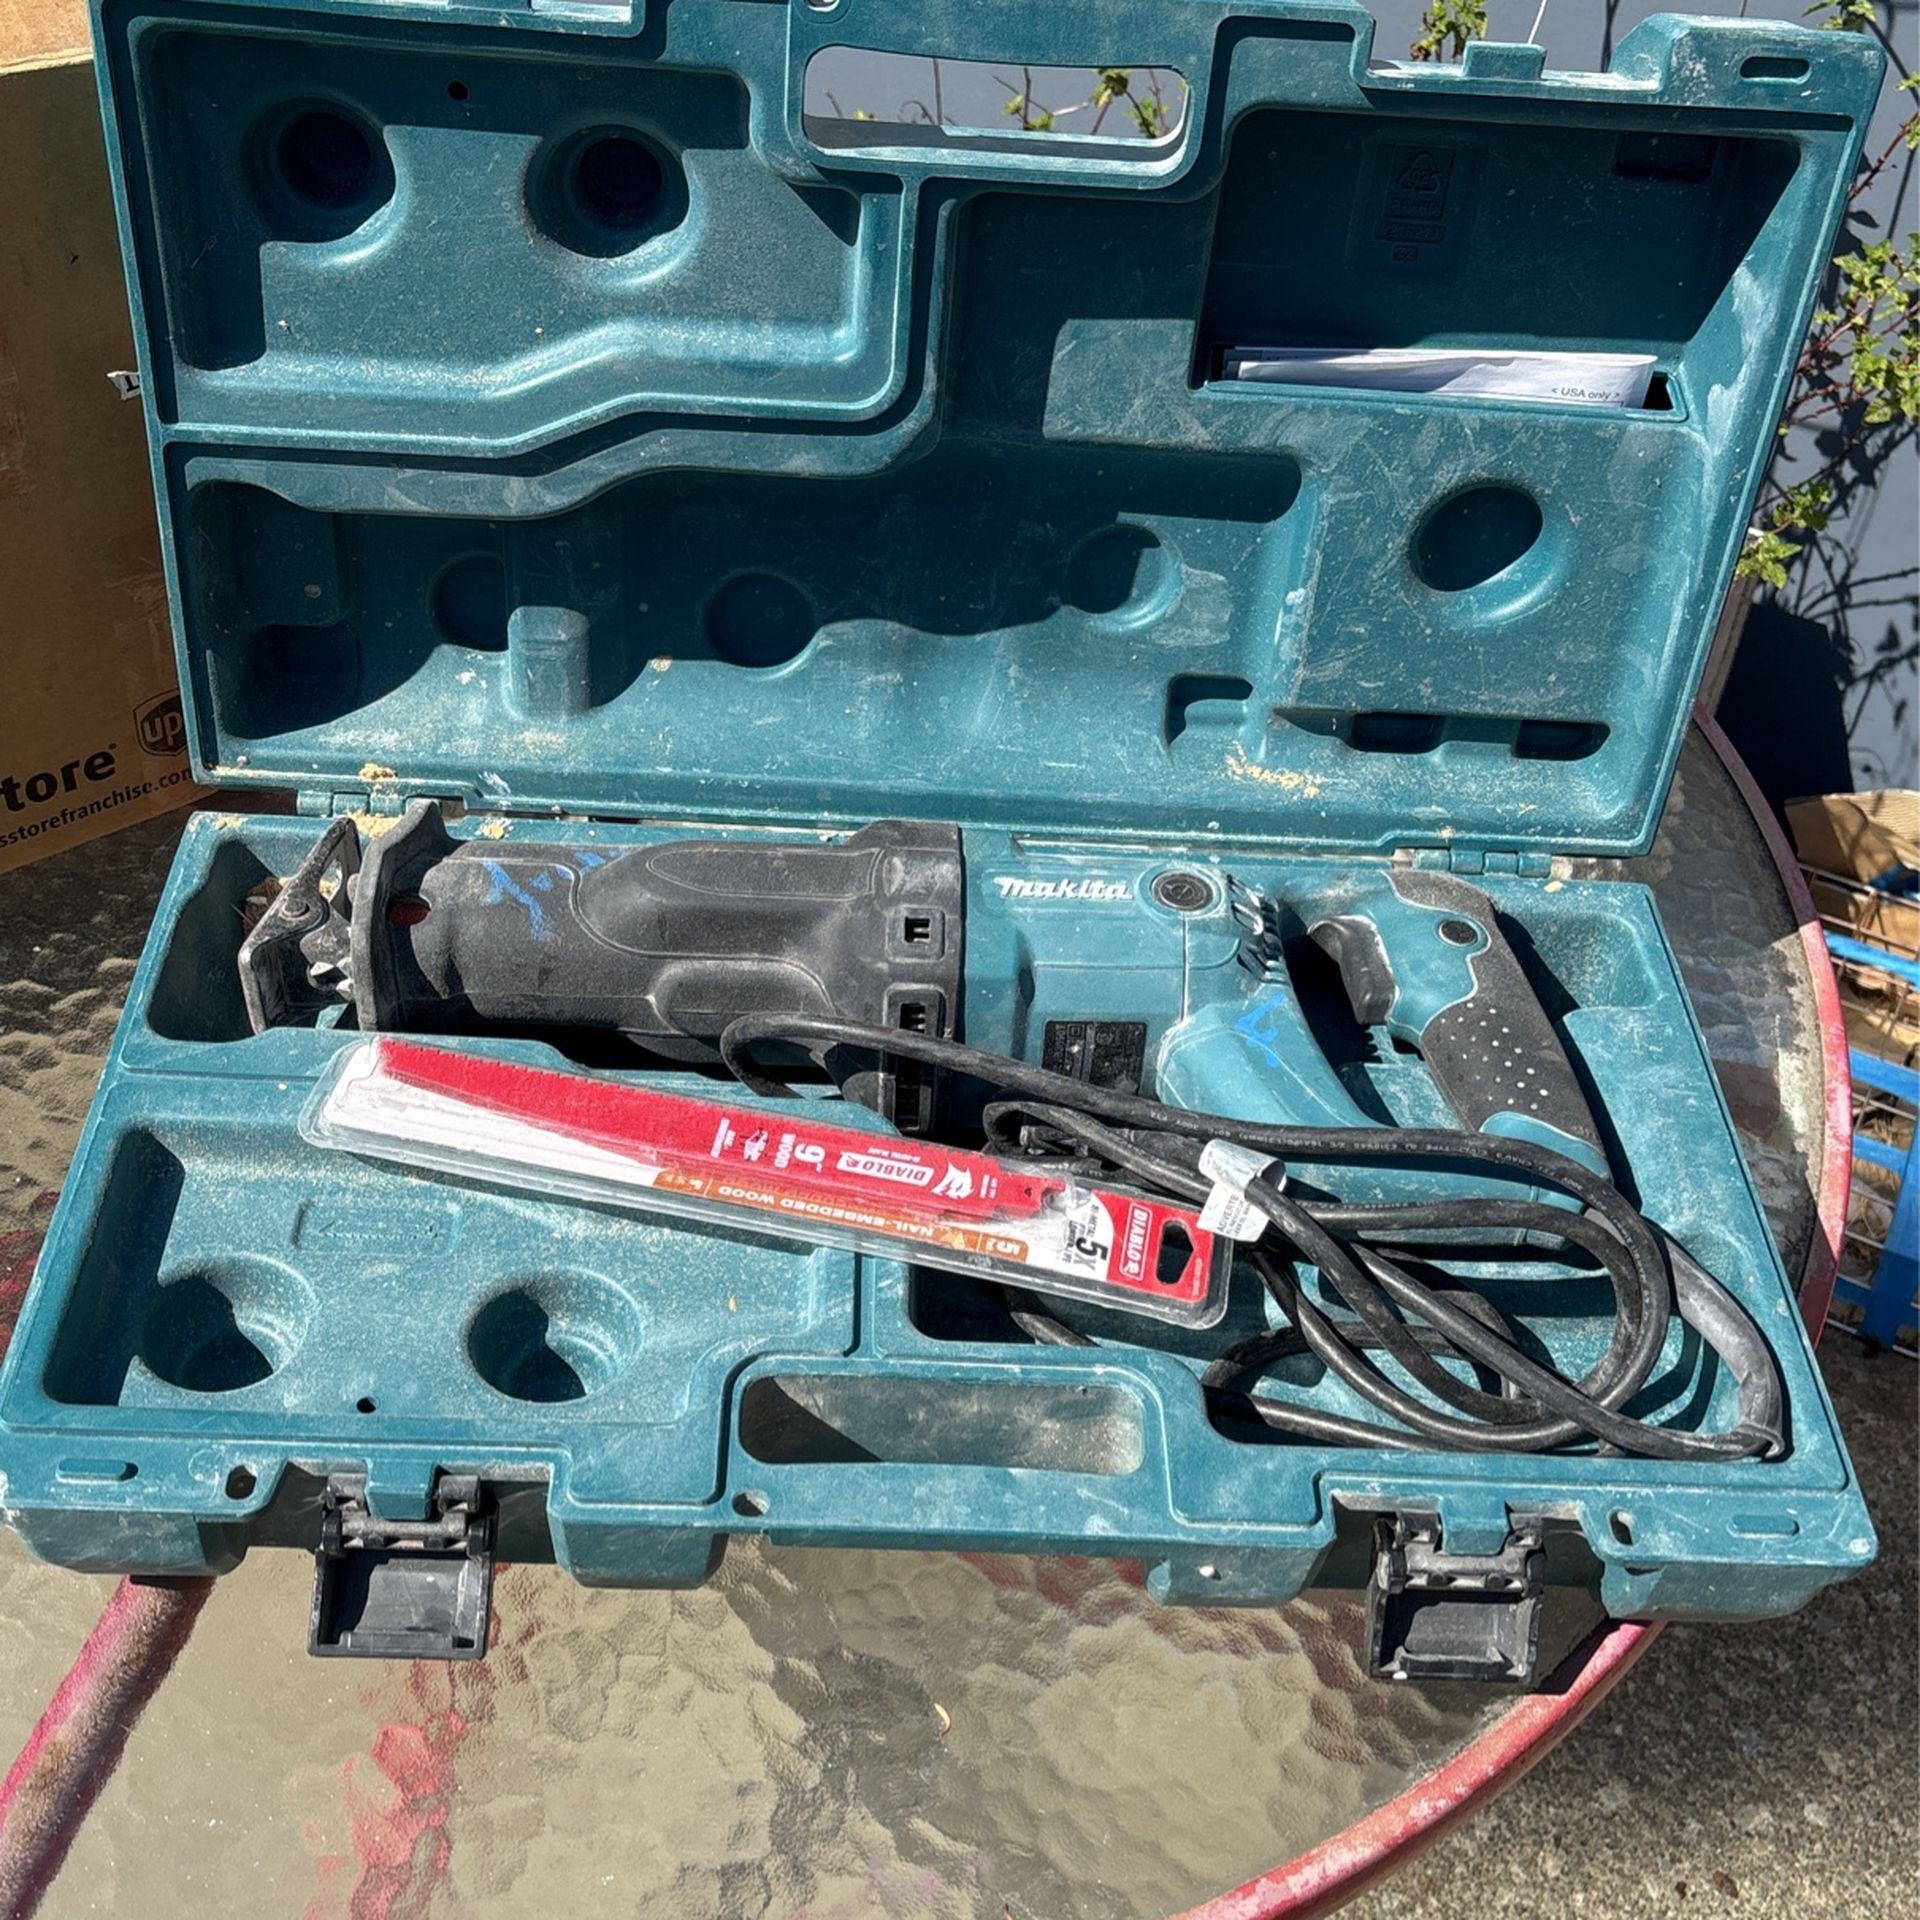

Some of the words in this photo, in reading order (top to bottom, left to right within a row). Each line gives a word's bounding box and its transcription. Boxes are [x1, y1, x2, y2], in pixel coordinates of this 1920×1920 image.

[1560, 386, 1586, 399] USA
[1588, 390, 1612, 402] only
[143, 711, 182, 746] up
[774, 1133, 797, 1169] WOOD
[861, 1157, 927, 1182] DIABLO
[717, 1185, 775, 1205] WOOD
[780, 1197, 934, 1237] NAIL-EMBEDDED
[1126, 1208, 1149, 1260] DIABLO
